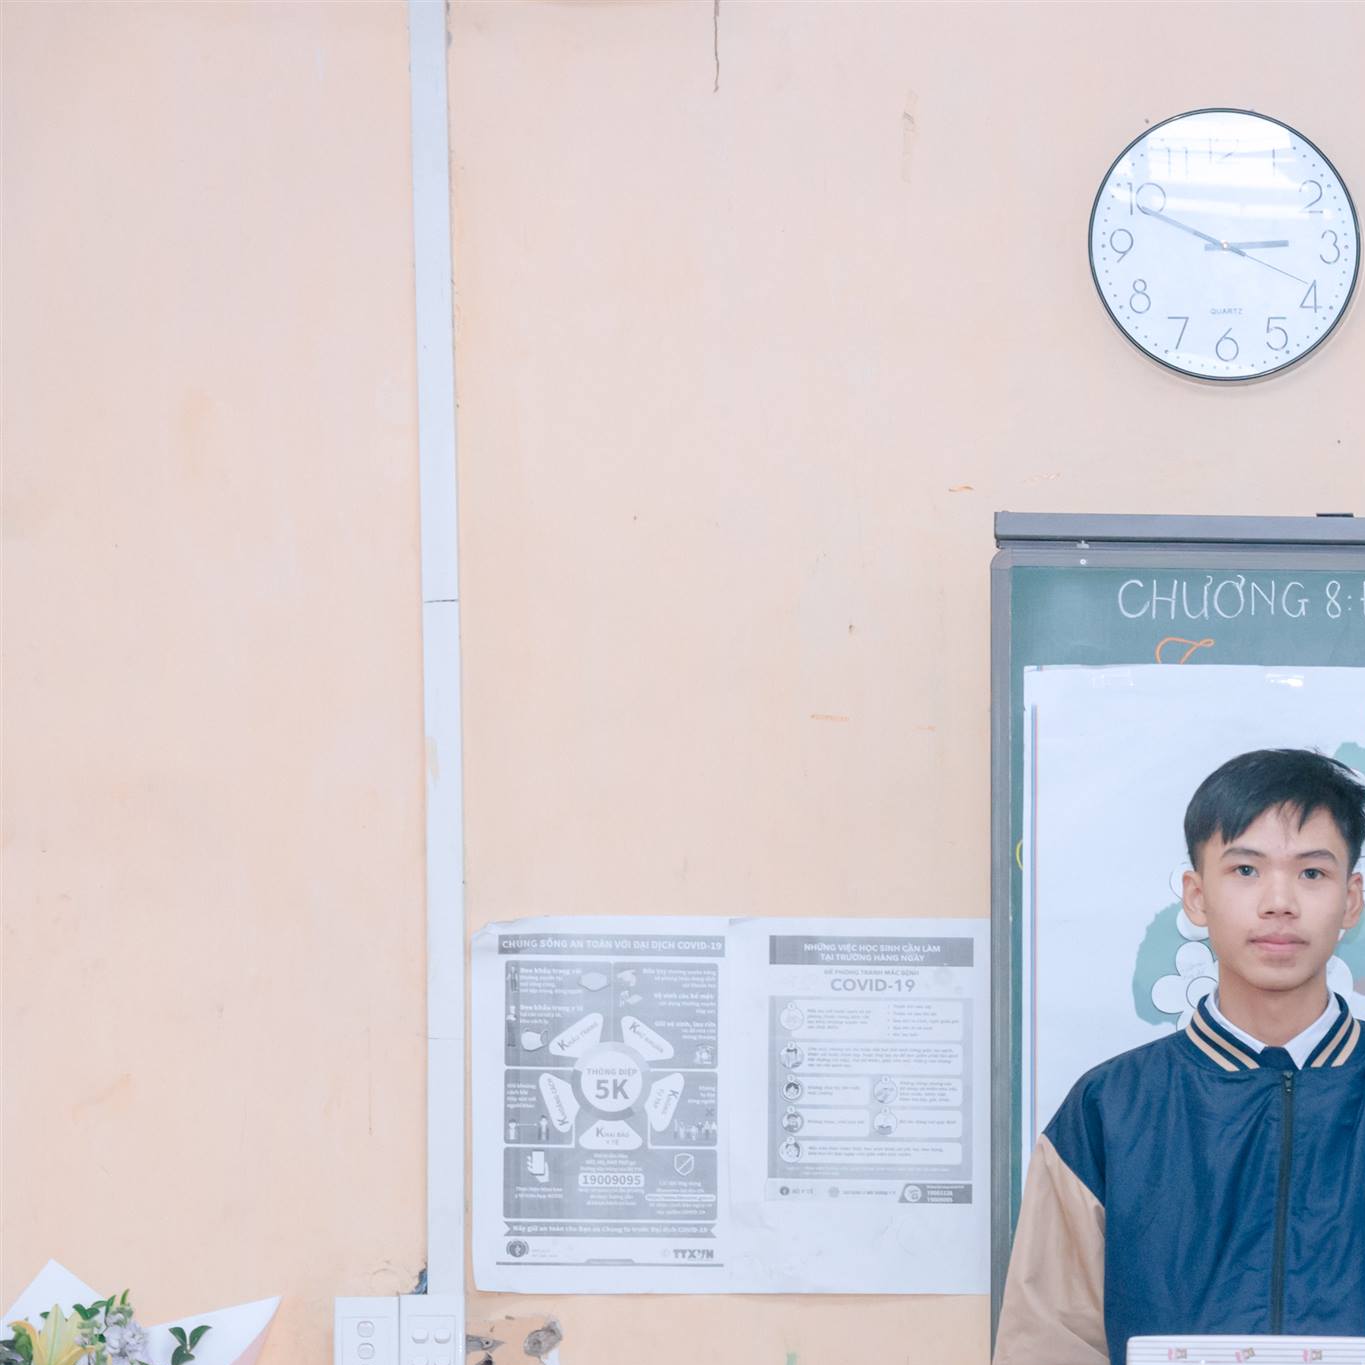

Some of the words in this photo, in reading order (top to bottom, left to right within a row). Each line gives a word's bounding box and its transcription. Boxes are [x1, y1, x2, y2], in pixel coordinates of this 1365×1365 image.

[1126, 183, 1166, 215] 10
[1299, 180, 1324, 214] 2
[1110, 229, 1133, 262] 9
[1320, 230, 1340, 264] 3
[1129, 279, 1151, 313] 8
[1210, 307, 1243, 315] QUARTZ
[1299, 280, 1322, 313] 4
[1168, 316, 1189, 350] 7
[1215, 328, 1239, 361] 6
[1266, 316, 1288, 350] 5
[1118, 574, 1309, 620] CHƯƠNG
[677, 941, 722, 951] COVID-19
[831, 978, 916, 992] COVID-19
[595, 1079, 630, 1100] 5K
[582, 1174, 641, 1185] 19009095
